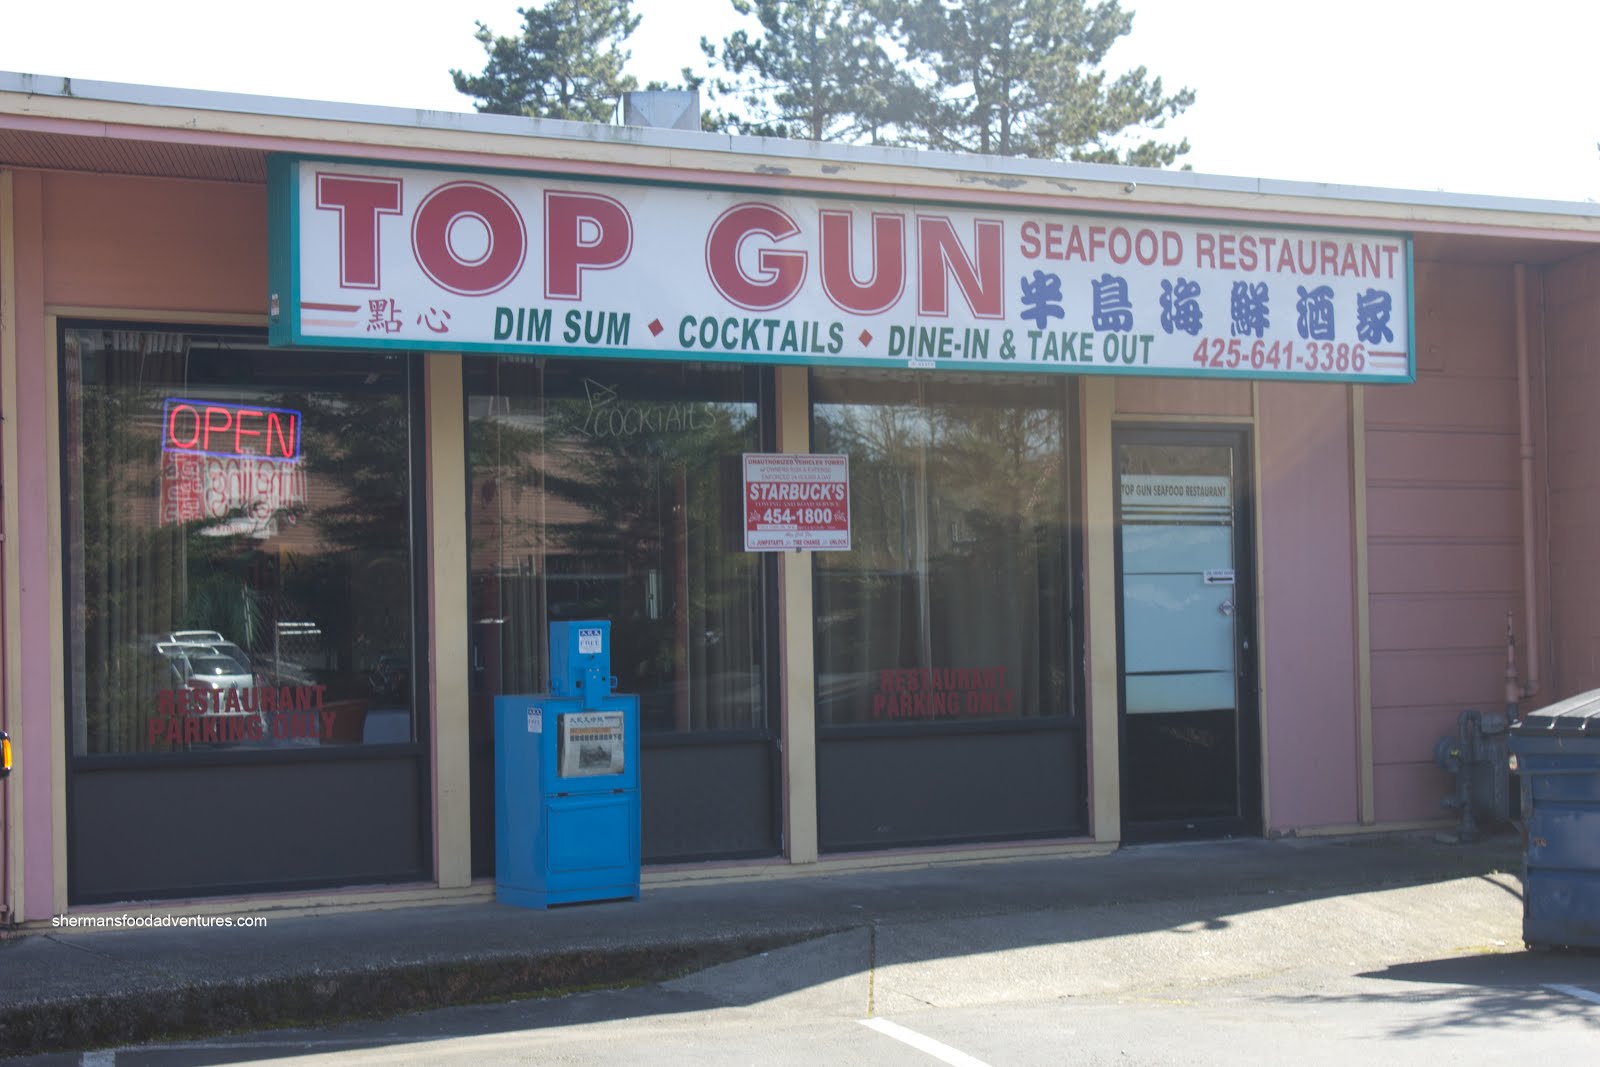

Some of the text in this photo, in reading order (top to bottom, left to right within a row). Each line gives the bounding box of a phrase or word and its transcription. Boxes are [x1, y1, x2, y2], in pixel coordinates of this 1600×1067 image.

[316, 171, 1004, 320] TOP GUN
[1020, 221, 1399, 279] SEAFOOD RESTAURANT
[366, 298, 451, 334] 點心
[1020, 270, 1394, 344] 半島海鮮酒家
[494, 306, 1154, 364] DIM SUM COCKTAILS DINE-IN & TAKE OUT
[1193, 338, 1365, 373] 425-641-3386
[169, 404, 295, 458] OPEN
[595, 403, 716, 437] COCKTAILS
[749, 483, 845, 501] STARBUCK'S
[1121, 485, 1226, 497] TOP GUN SEAFOOD RESTAURANT
[763, 508, 832, 524] 454-1800
[881, 665, 1007, 692] RESTAURANT
[158, 684, 326, 715] RESTAURANT
[873, 688, 1016, 717] PARKING ONLY
[148, 712, 336, 745] PARKING ONLY
